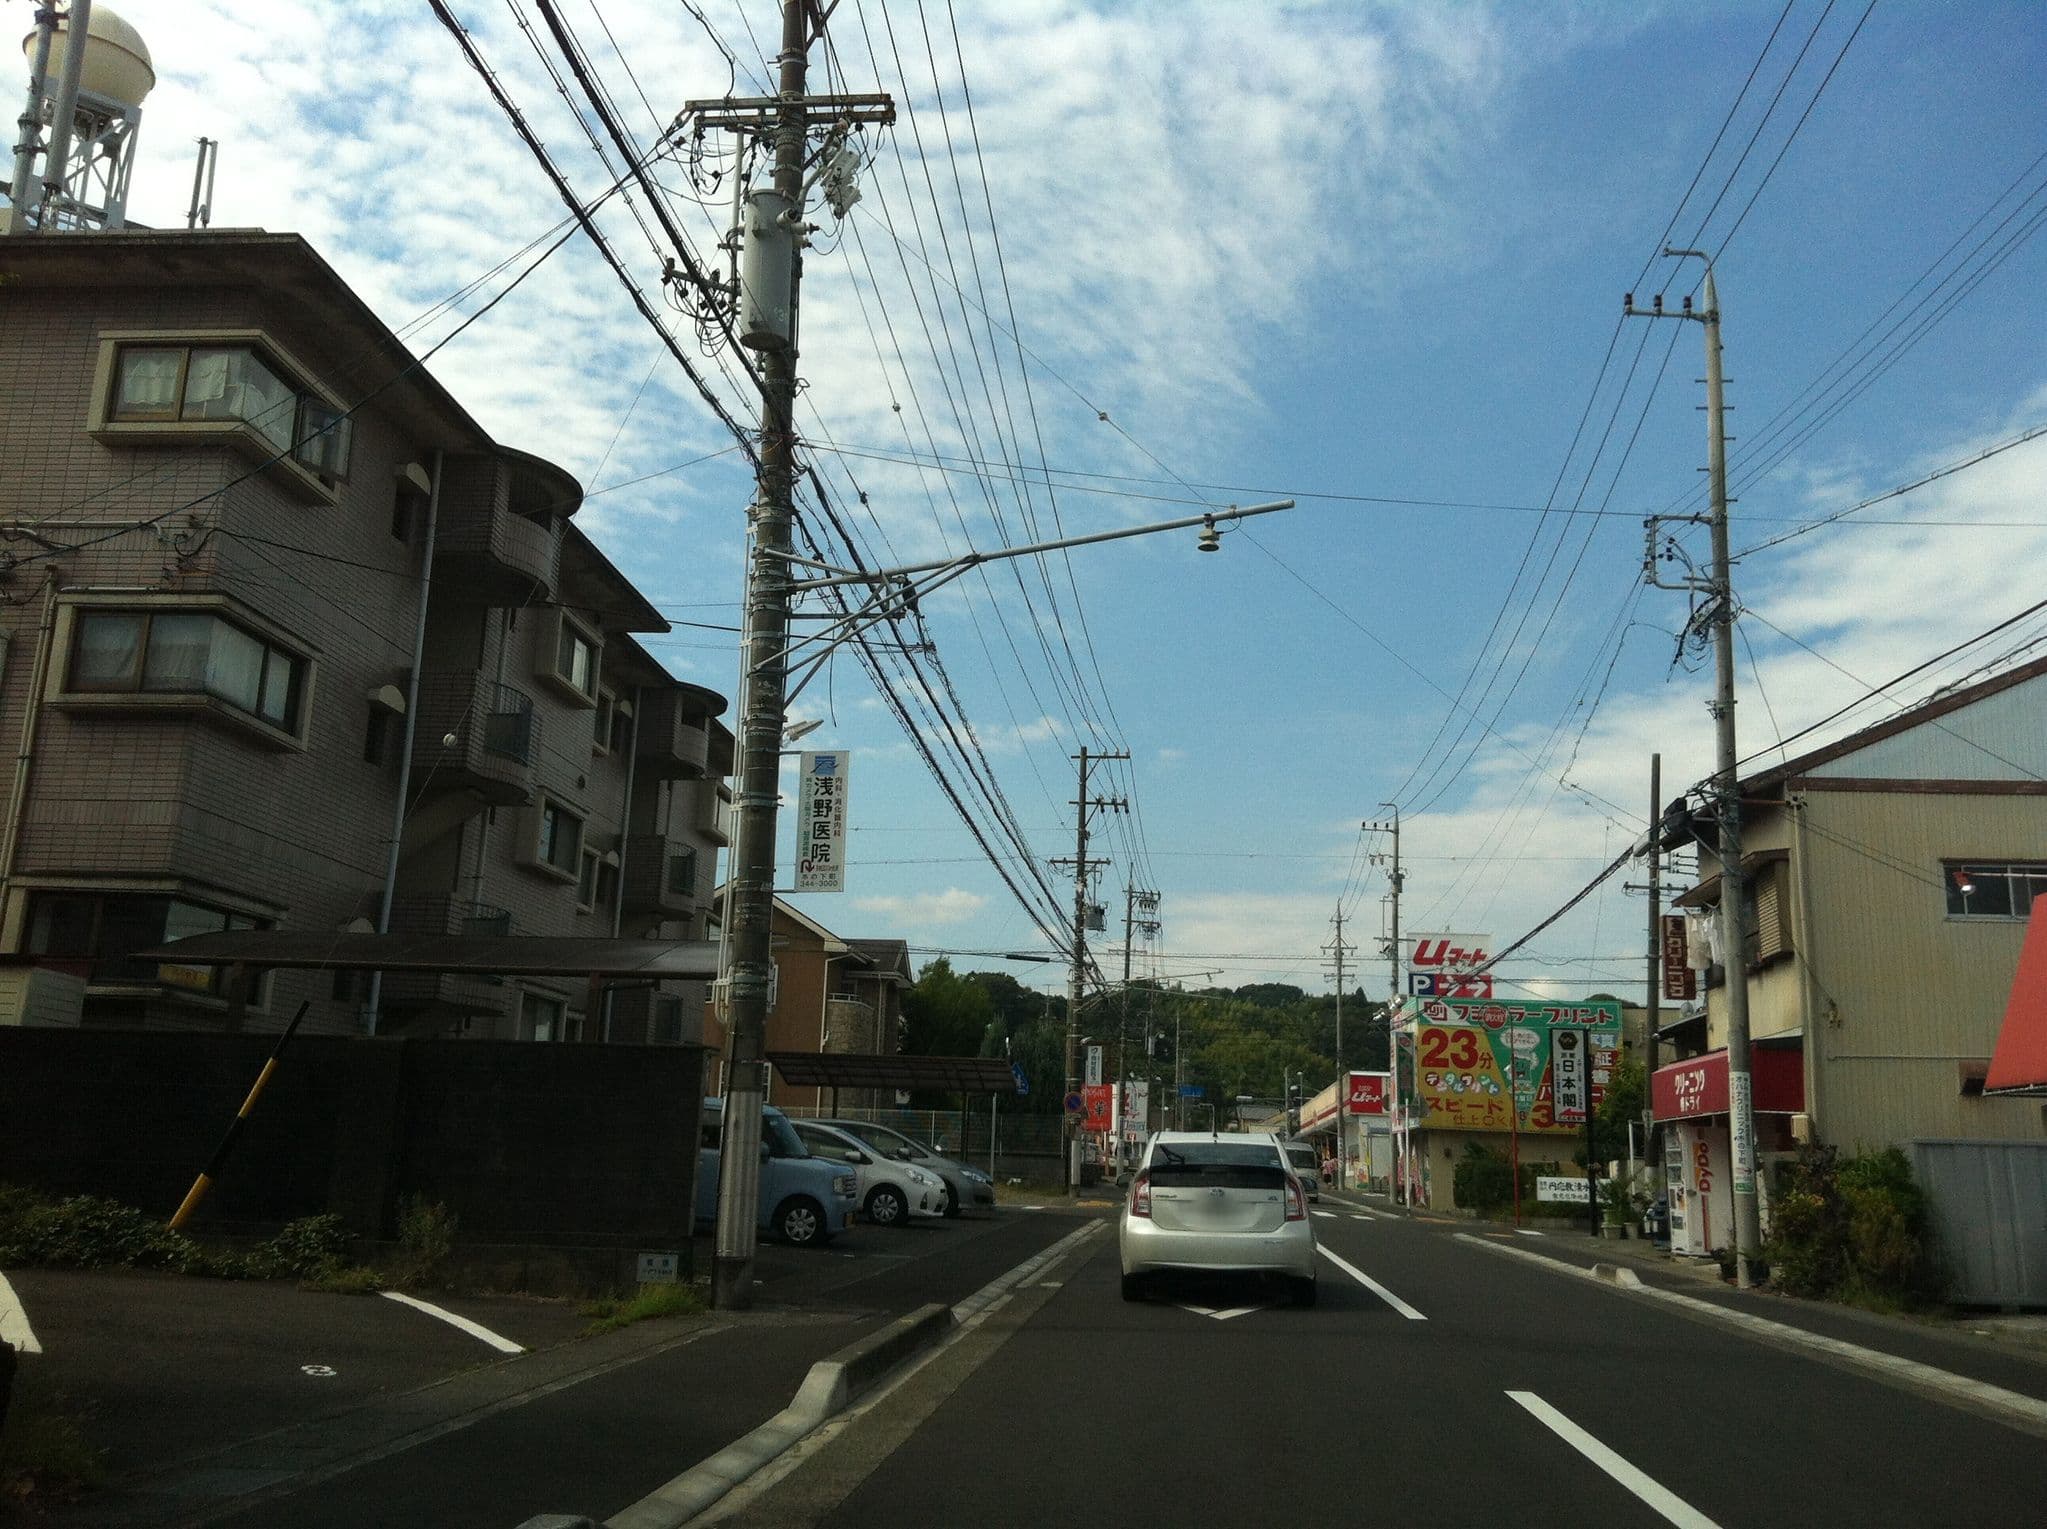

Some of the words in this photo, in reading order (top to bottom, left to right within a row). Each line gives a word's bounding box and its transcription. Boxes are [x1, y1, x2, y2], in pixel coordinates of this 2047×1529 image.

[810, 777, 834, 863] 浅野医院
[1412, 939, 1487, 966] Uマート
[1412, 975, 1431, 994] P
[1452, 1005, 1615, 1025] フジラープリント
[1421, 1028, 1494, 1069] 23分
[1425, 1072, 1499, 1095] デジタルプリント
[1561, 1060, 1577, 1107] 日本閣
[1675, 1069, 1705, 1095] クリーニング
[1426, 1096, 1504, 1113] スピード
[1697, 1142, 1713, 1192] DyDo
